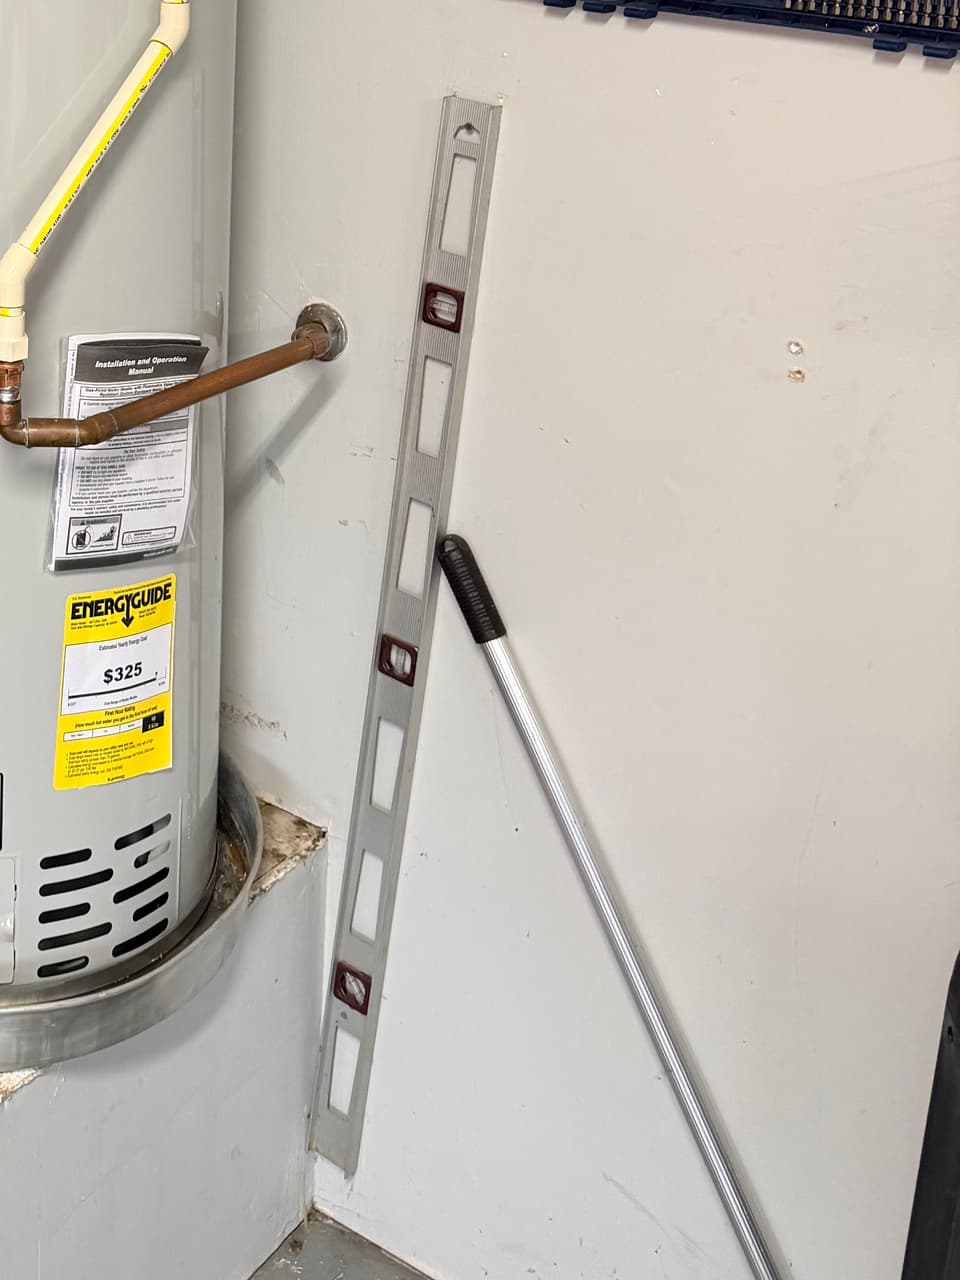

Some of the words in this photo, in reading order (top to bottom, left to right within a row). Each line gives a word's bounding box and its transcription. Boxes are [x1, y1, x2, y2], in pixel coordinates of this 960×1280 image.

[95, 359, 135, 368] Installation
[137, 357, 150, 365] and
[152, 356, 187, 365] Operation
[128, 367, 154, 376] Manual
[71, 582, 172, 620] ENERGYGUIDE
[103, 661, 142, 685] $325
